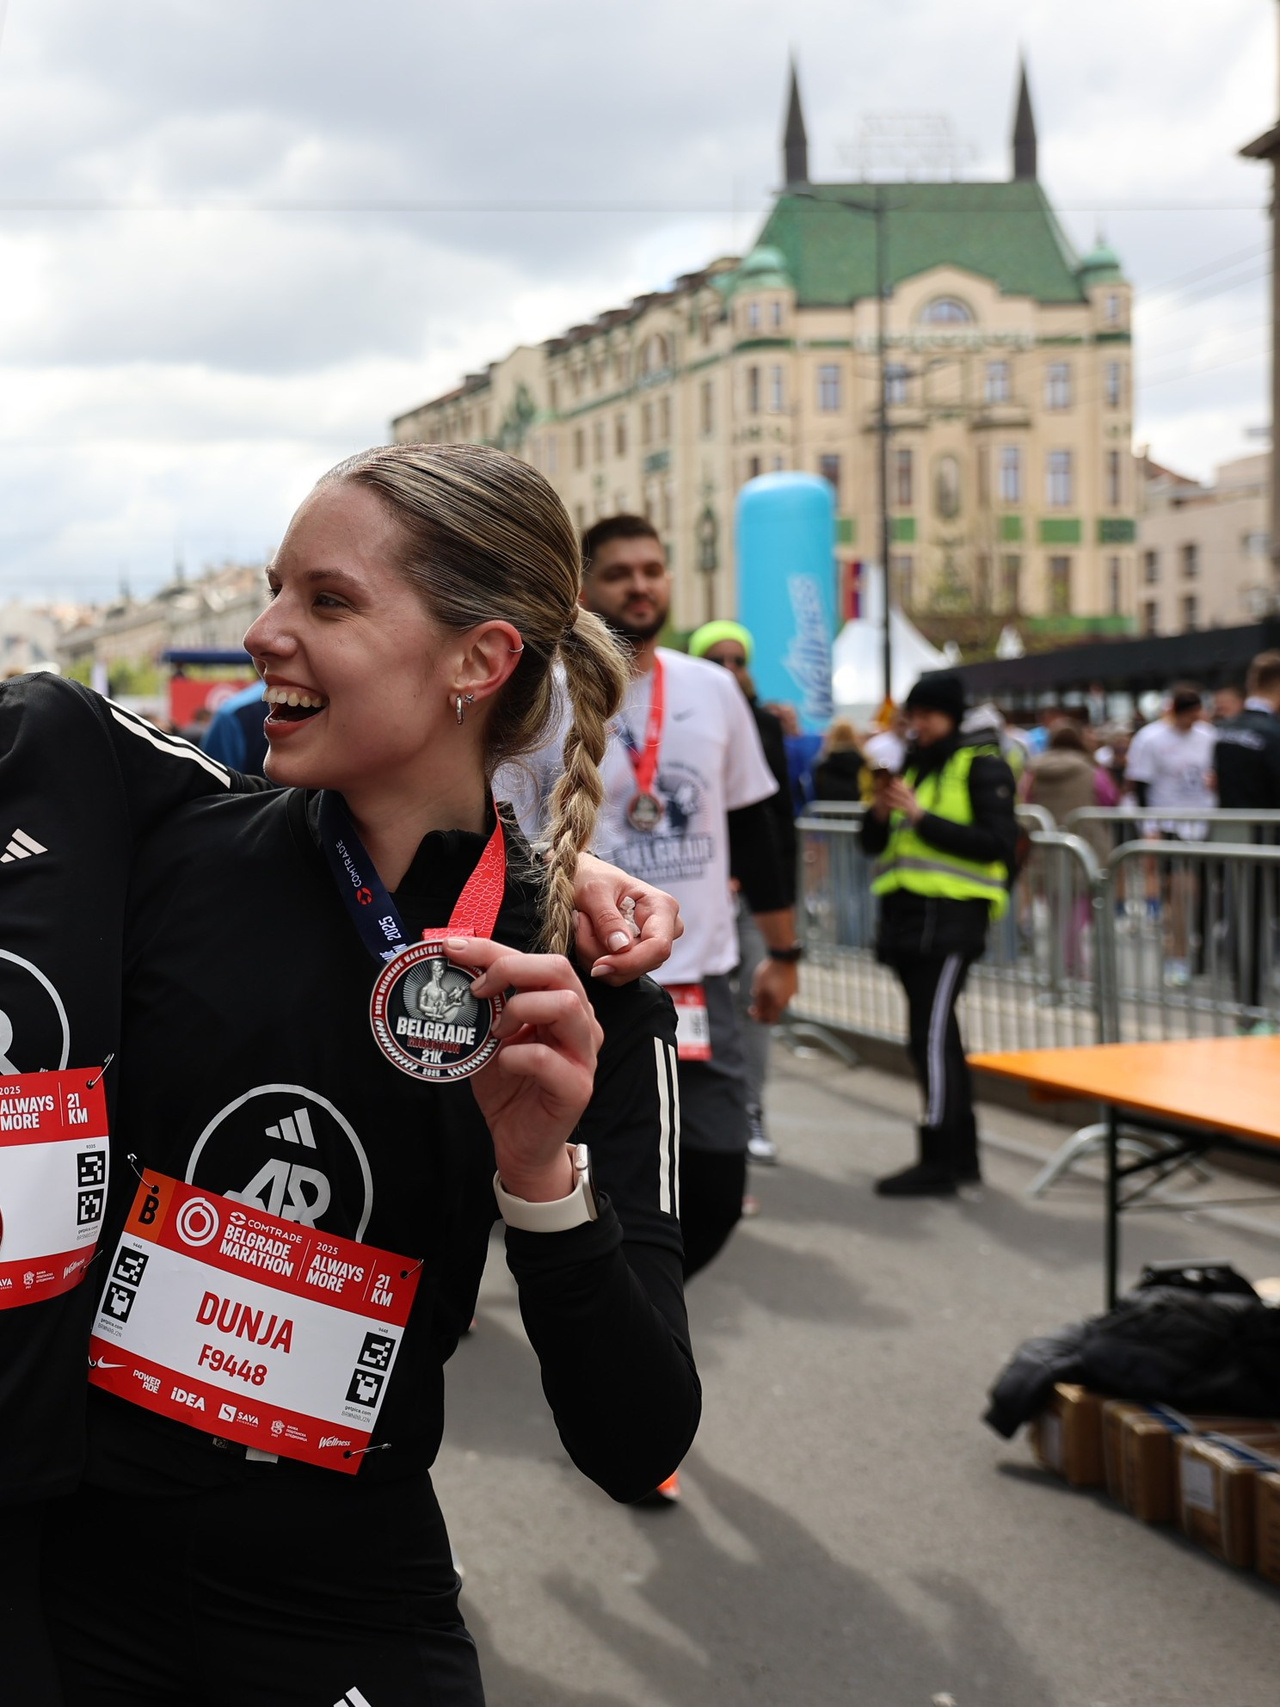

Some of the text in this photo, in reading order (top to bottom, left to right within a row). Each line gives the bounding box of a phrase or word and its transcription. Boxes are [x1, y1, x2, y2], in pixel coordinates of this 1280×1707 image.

[335, 839, 362, 888] COMTRADE
[378, 915, 401, 941] 2025
[396, 1016, 476, 1045] BELGRADE
[421, 1049, 442, 1064] 21K
[0, 1095, 55, 1115] ALWAYS
[67, 1093, 80, 1108] 21
[0, 1113, 40, 1131] MORE
[68, 1108, 88, 1125] KM
[138, 1195, 160, 1225] B
[224, 1224, 292, 1259] BELGRADE
[248, 1219, 303, 1244] COMTRADE
[219, 1239, 294, 1277] MARATHON
[316, 1242, 339, 1255] 2025
[310, 1254, 364, 1282] ALWAYS
[305, 1269, 345, 1293] MORE
[375, 1274, 391, 1290] 21
[371, 1288, 393, 1307] KM
[195, 1291, 293, 1353] DUNJA
[197, 1343, 268, 1386] F9448
[133, 1369, 161, 1386] POWER
[142, 1382, 159, 1394] ADE
[238, 1412, 259, 1425] SAVA
[318, 1436, 351, 1449] Wellness
